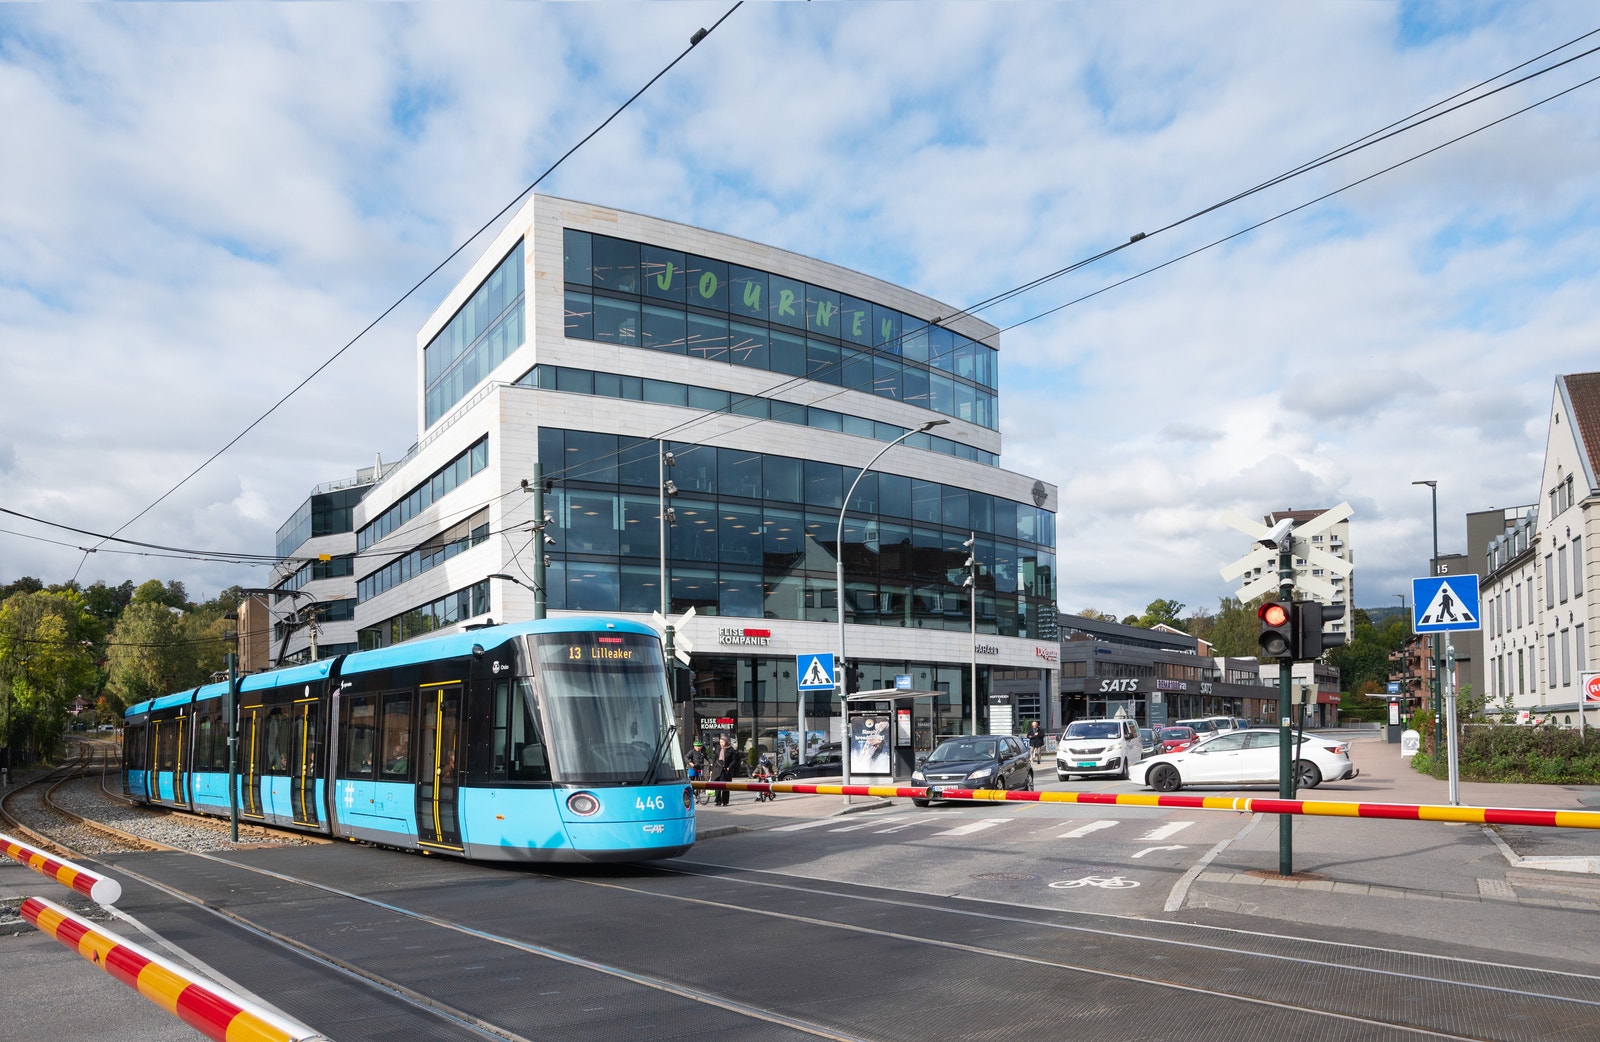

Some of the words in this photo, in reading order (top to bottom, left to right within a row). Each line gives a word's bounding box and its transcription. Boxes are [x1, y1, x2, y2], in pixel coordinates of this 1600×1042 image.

[656, 261, 893, 343] JOURNEY
[1437, 564, 1448, 574] 15
[719, 628, 744, 636] FLISE
[719, 636, 771, 645] KOMPANIET
[569, 646, 581, 659] 13
[591, 647, 632, 659] Lilleaker
[1099, 679, 1138, 692] SATS
[1201, 682, 1212, 694] SATS
[635, 795, 665, 811] 446
[642, 824, 665, 834] CAF
